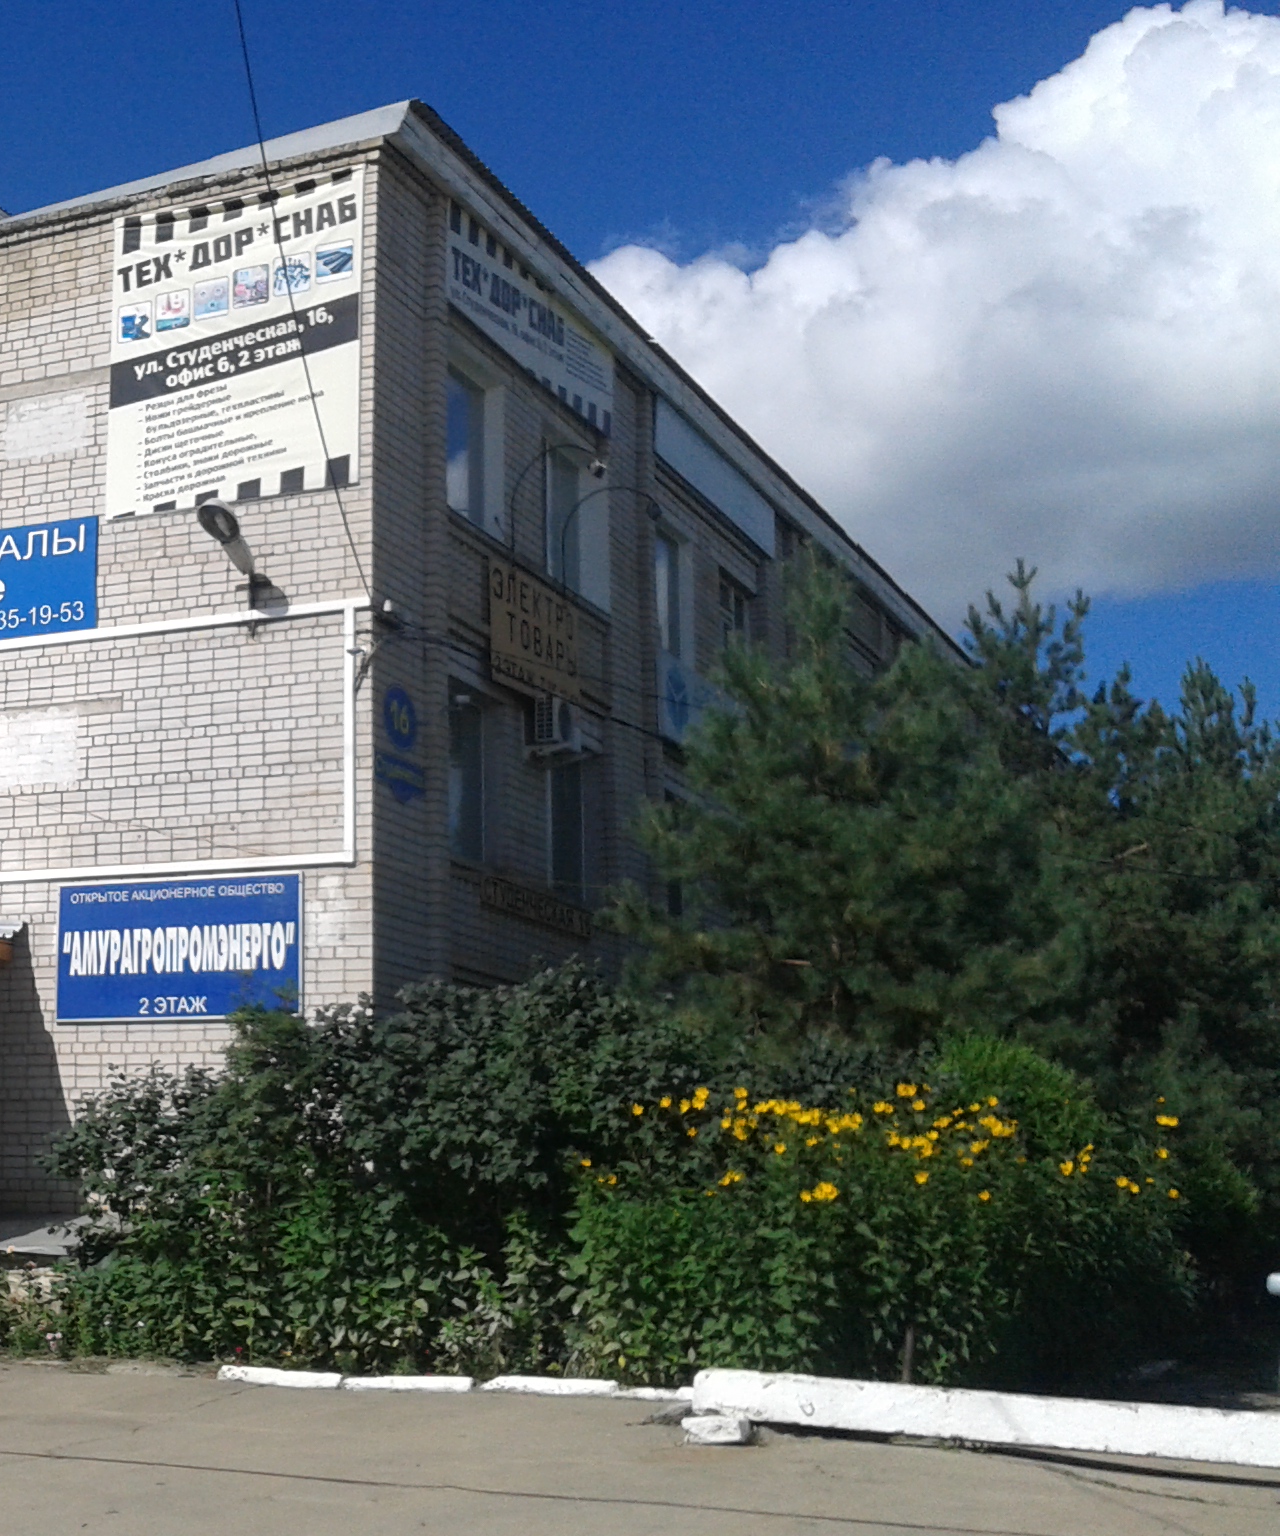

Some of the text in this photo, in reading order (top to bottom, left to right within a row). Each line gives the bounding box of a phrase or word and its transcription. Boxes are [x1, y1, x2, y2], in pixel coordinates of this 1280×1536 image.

[133, 307, 334, 381] ул. Студенческая, 16,
[165, 338, 302, 388] офис 6, 2 этаж
[70, 882, 284, 905] ОТКРЫТОЕ АКЦИОНЕРНОЕ ОБЩЕСТВО
[63, 921, 295, 976] "АМУРАГРОПРОМЭНЕРГО"
[139, 995, 207, 1014] 2 ЭТАЖ
